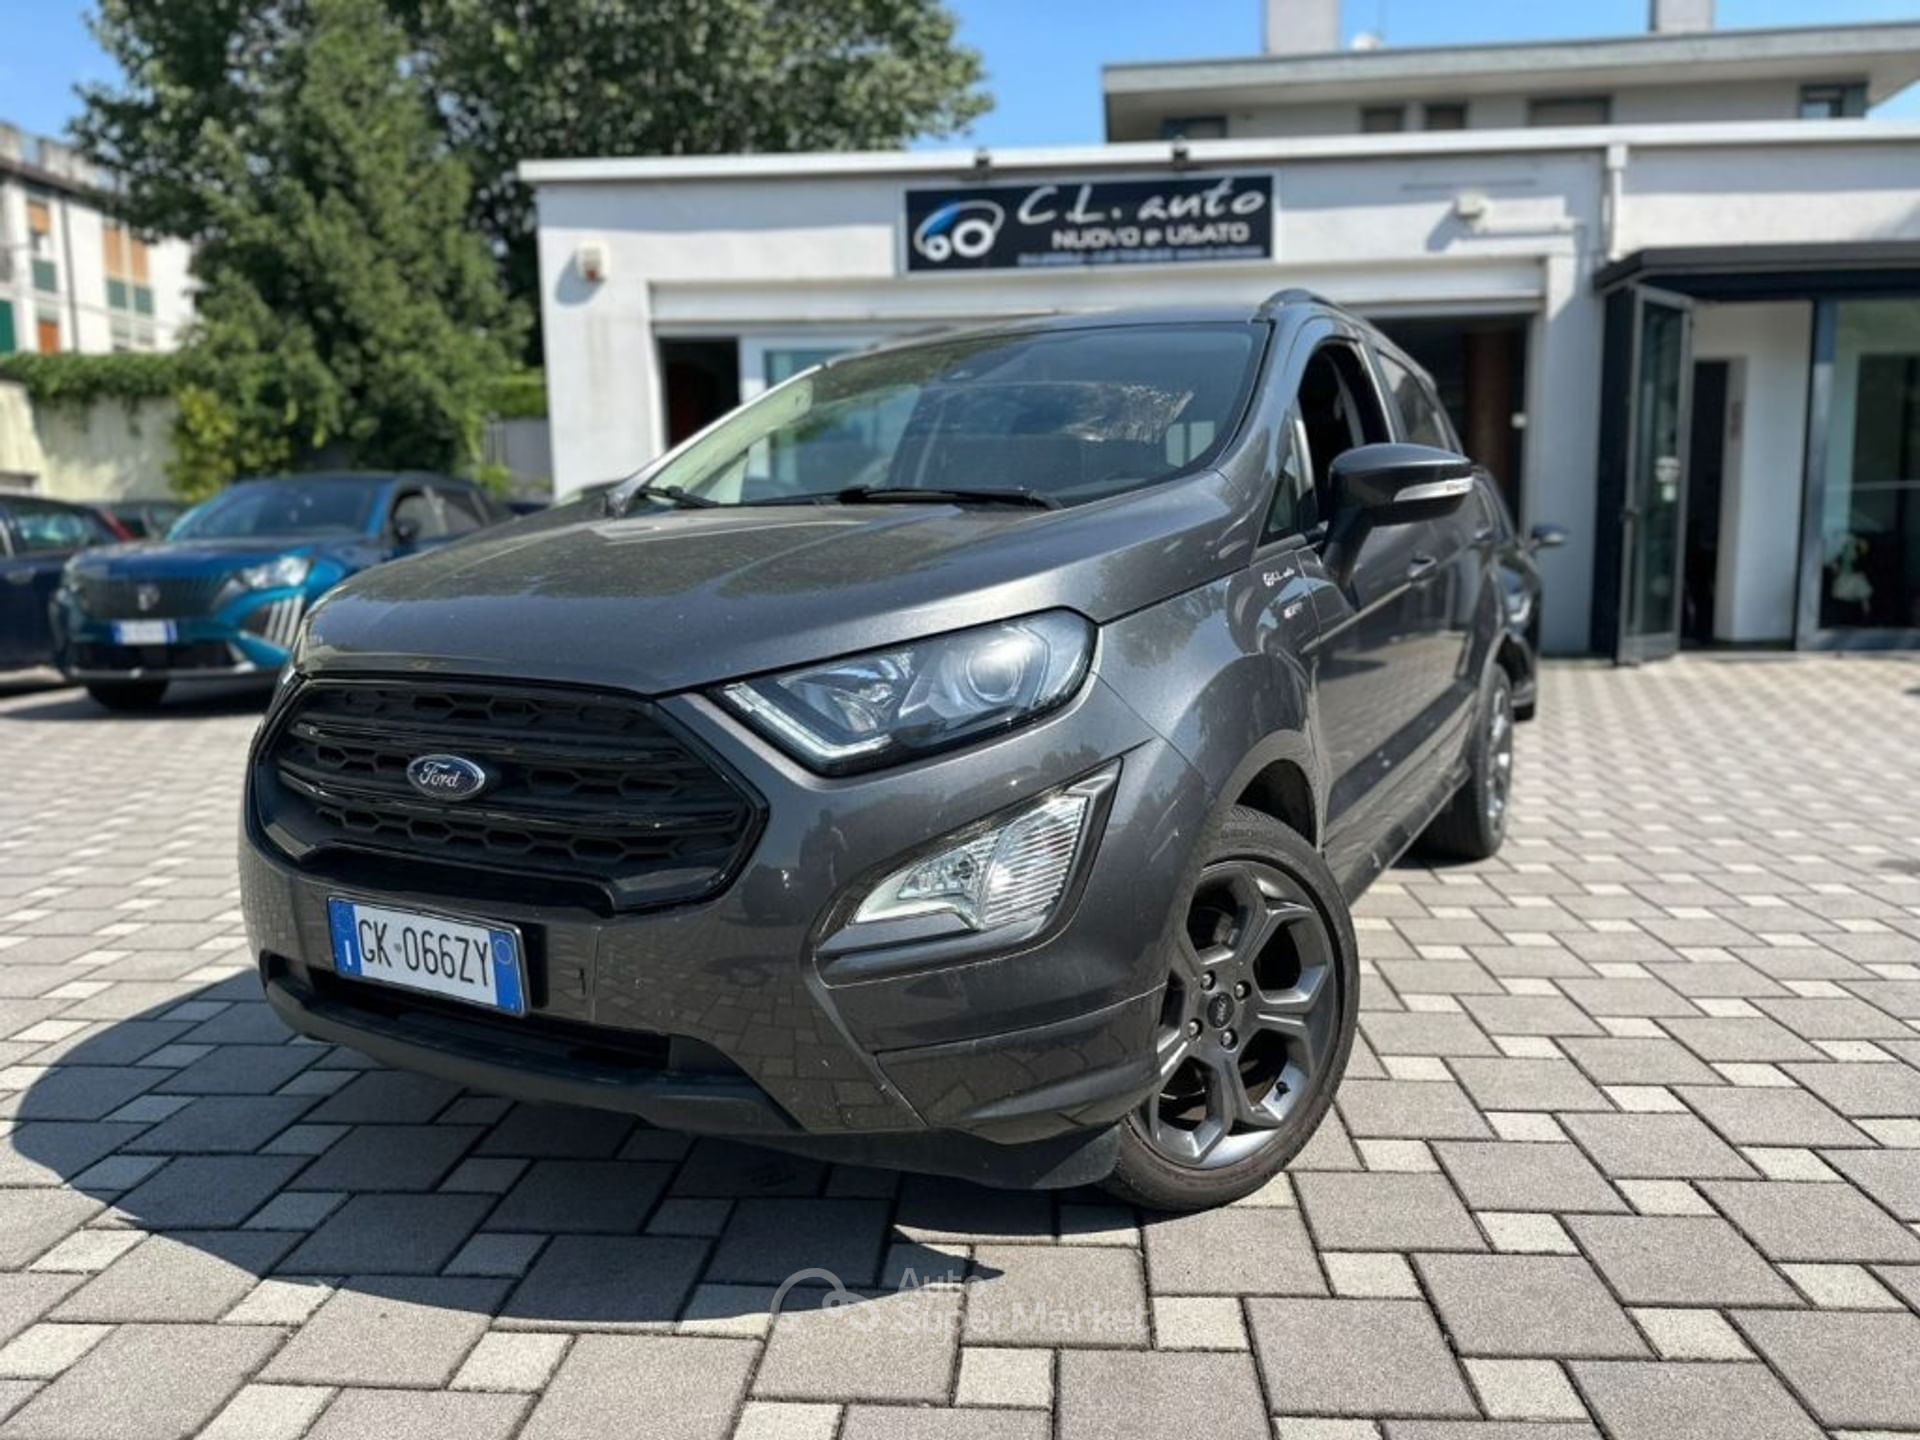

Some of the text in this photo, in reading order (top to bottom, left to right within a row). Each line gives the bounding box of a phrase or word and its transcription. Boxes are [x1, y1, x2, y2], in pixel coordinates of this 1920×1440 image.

[1137, 178, 1266, 221] auto
[1053, 227, 1139, 248] NUOVO
[1166, 222, 1250, 245] USATO
[418, 760, 462, 788] Ford
